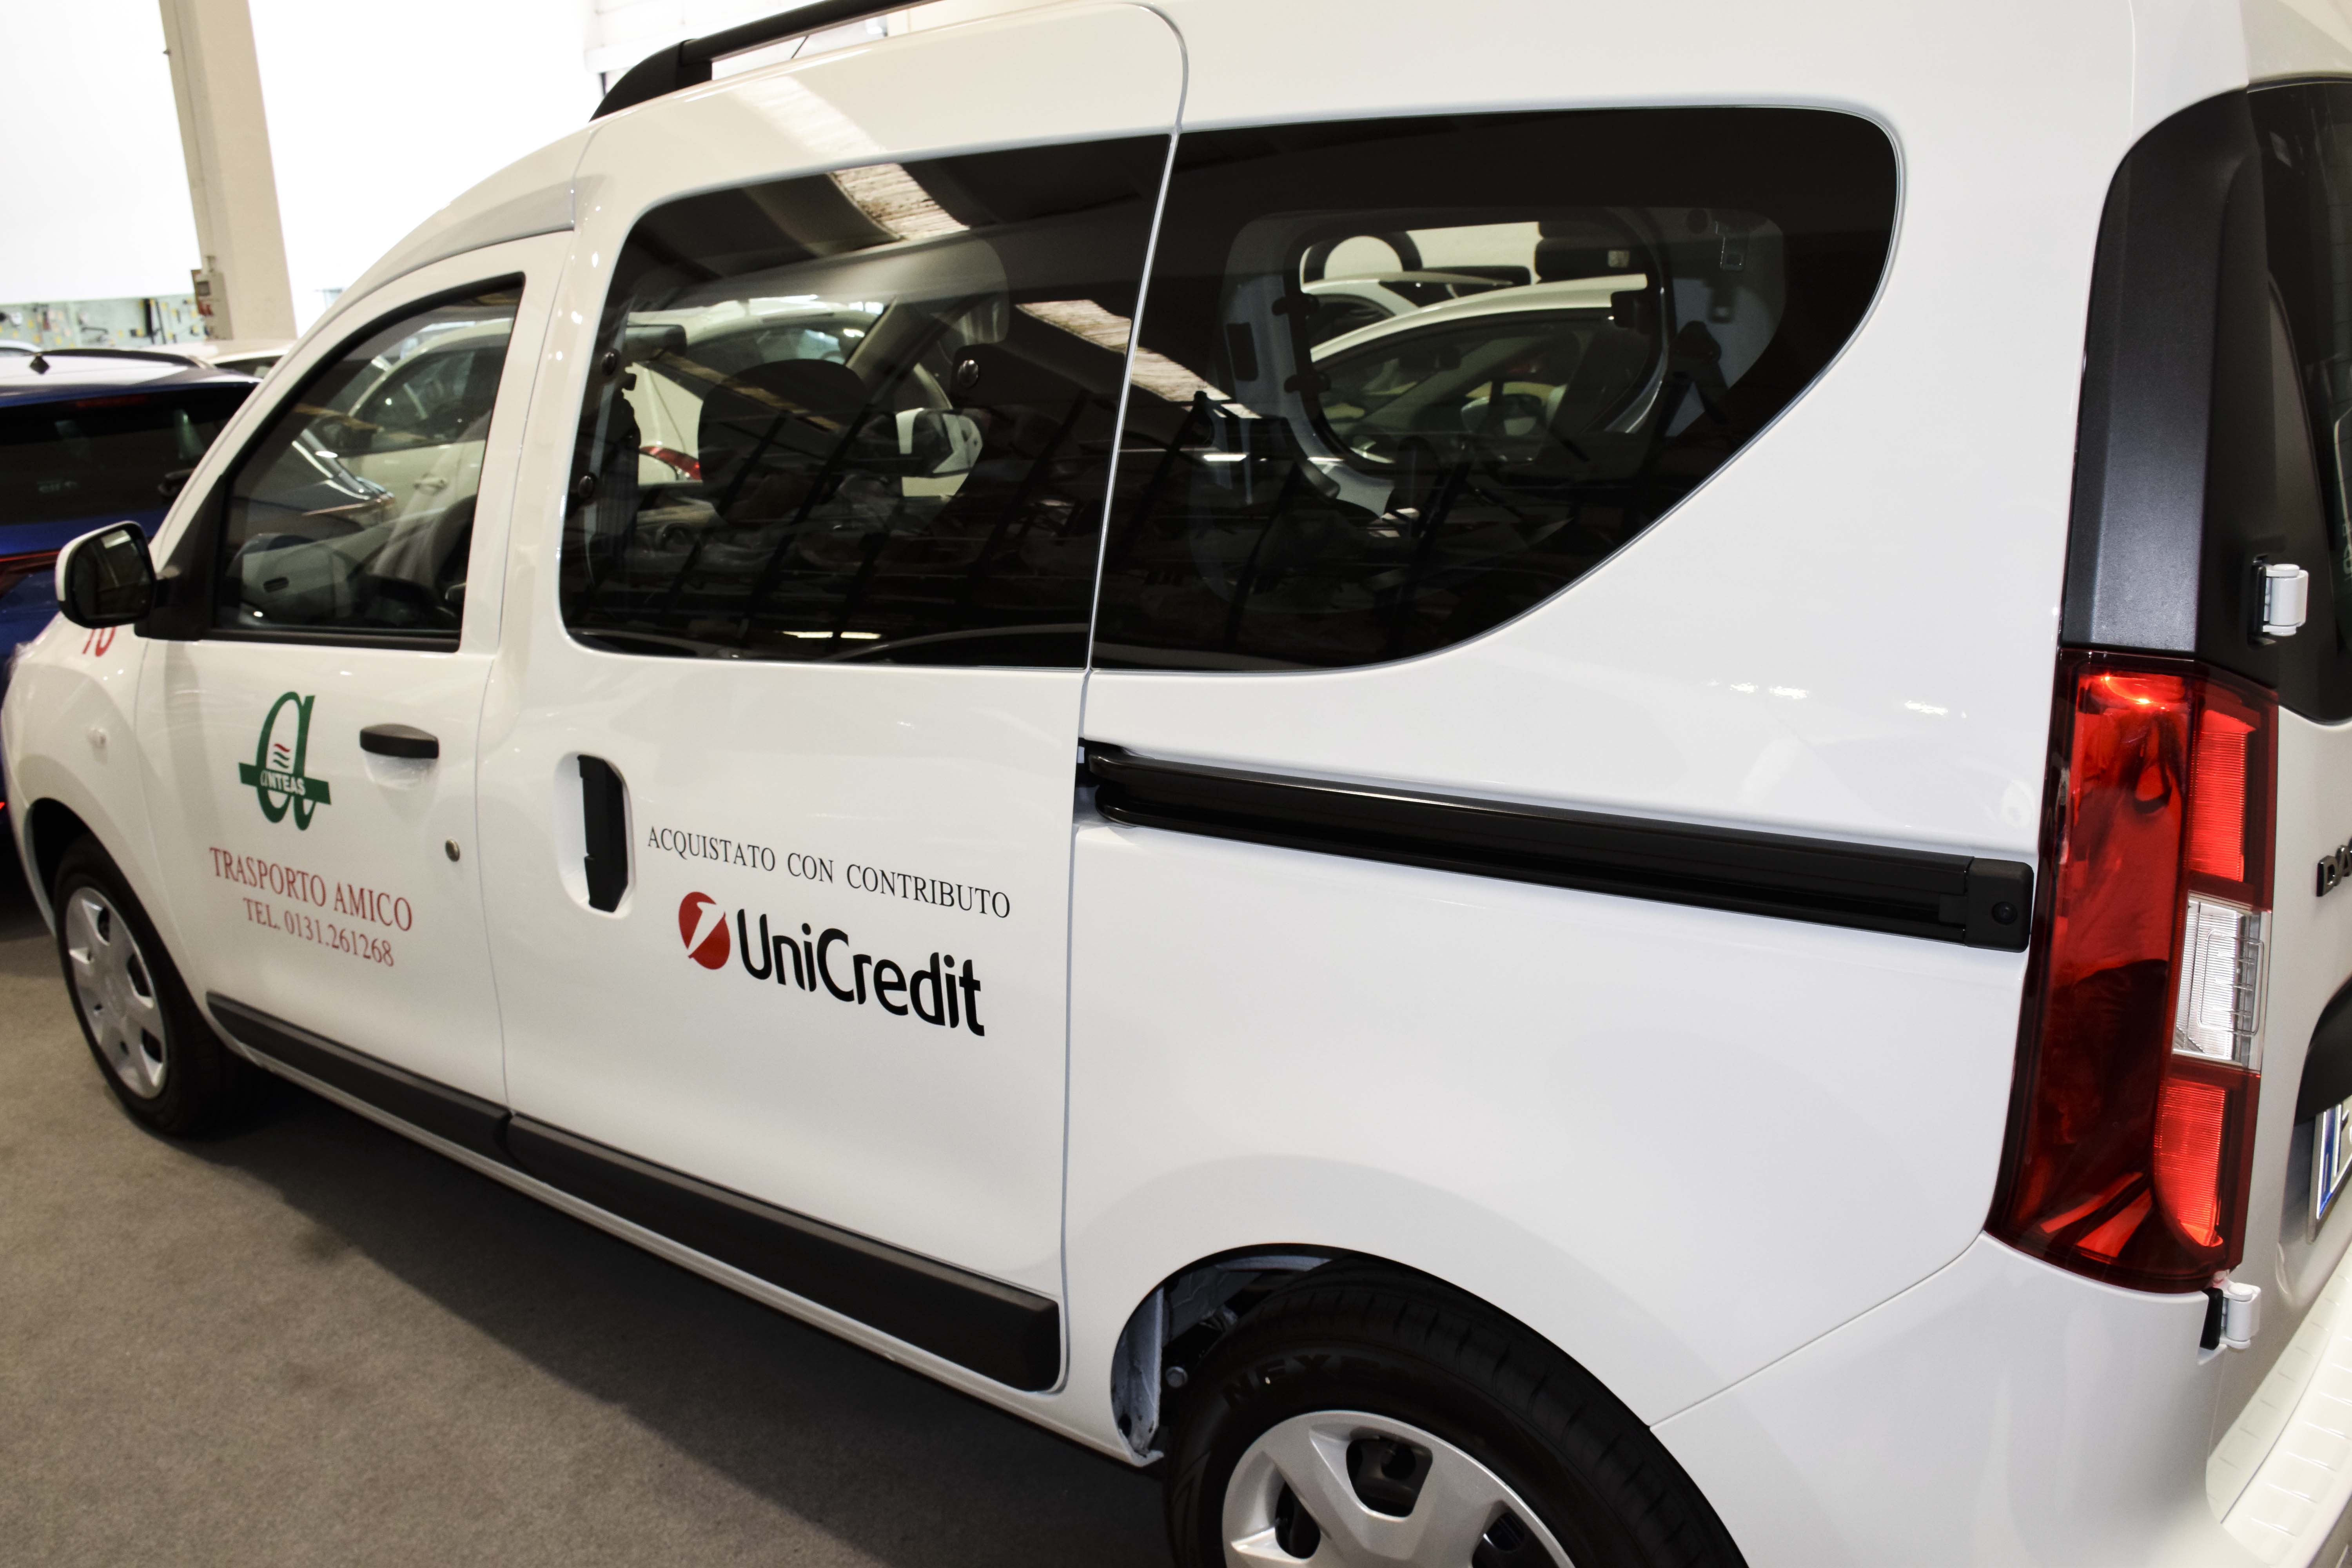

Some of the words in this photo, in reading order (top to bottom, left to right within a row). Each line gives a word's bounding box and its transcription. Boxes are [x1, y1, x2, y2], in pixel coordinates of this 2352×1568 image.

[210, 847, 326, 907] TRASPORTO
[334, 883, 412, 931] AMICO
[648, 826, 775, 872] ACQUISTATO
[787, 852, 834, 884] CON
[846, 864, 1011, 919] CONTRIBUTO
[2316, 835, 2352, 897] DA
[243, 897, 280, 930] TEL.
[284, 909, 395, 967] 0131.261268
[737, 909, 985, 1037] UniCredit
